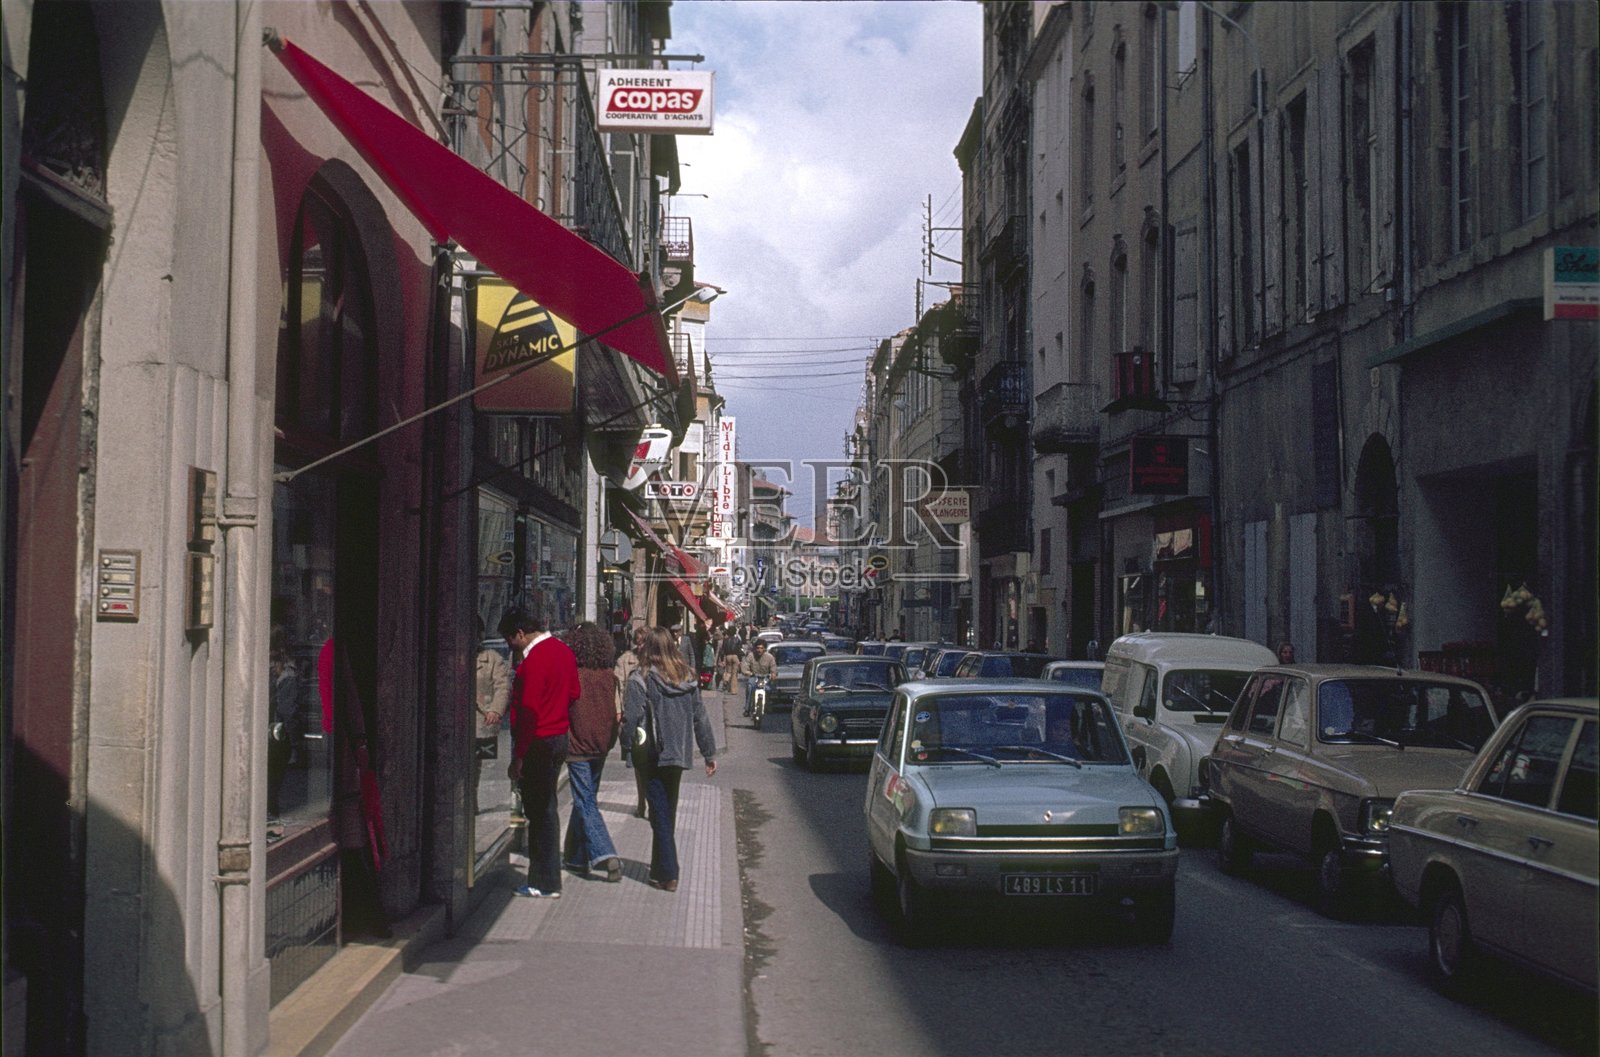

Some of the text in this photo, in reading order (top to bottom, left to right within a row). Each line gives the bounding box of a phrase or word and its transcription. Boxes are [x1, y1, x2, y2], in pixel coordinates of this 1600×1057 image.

[608, 78, 672, 87] ADHERENT
[614, 90, 694, 111] coopas
[496, 334, 520, 350] SKIS
[486, 333, 559, 370] DYNAMIC
[722, 422, 733, 510] Midi Libre
[647, 484, 695, 496] LOTO
[1013, 878, 1086, 893] 489 LS 11
